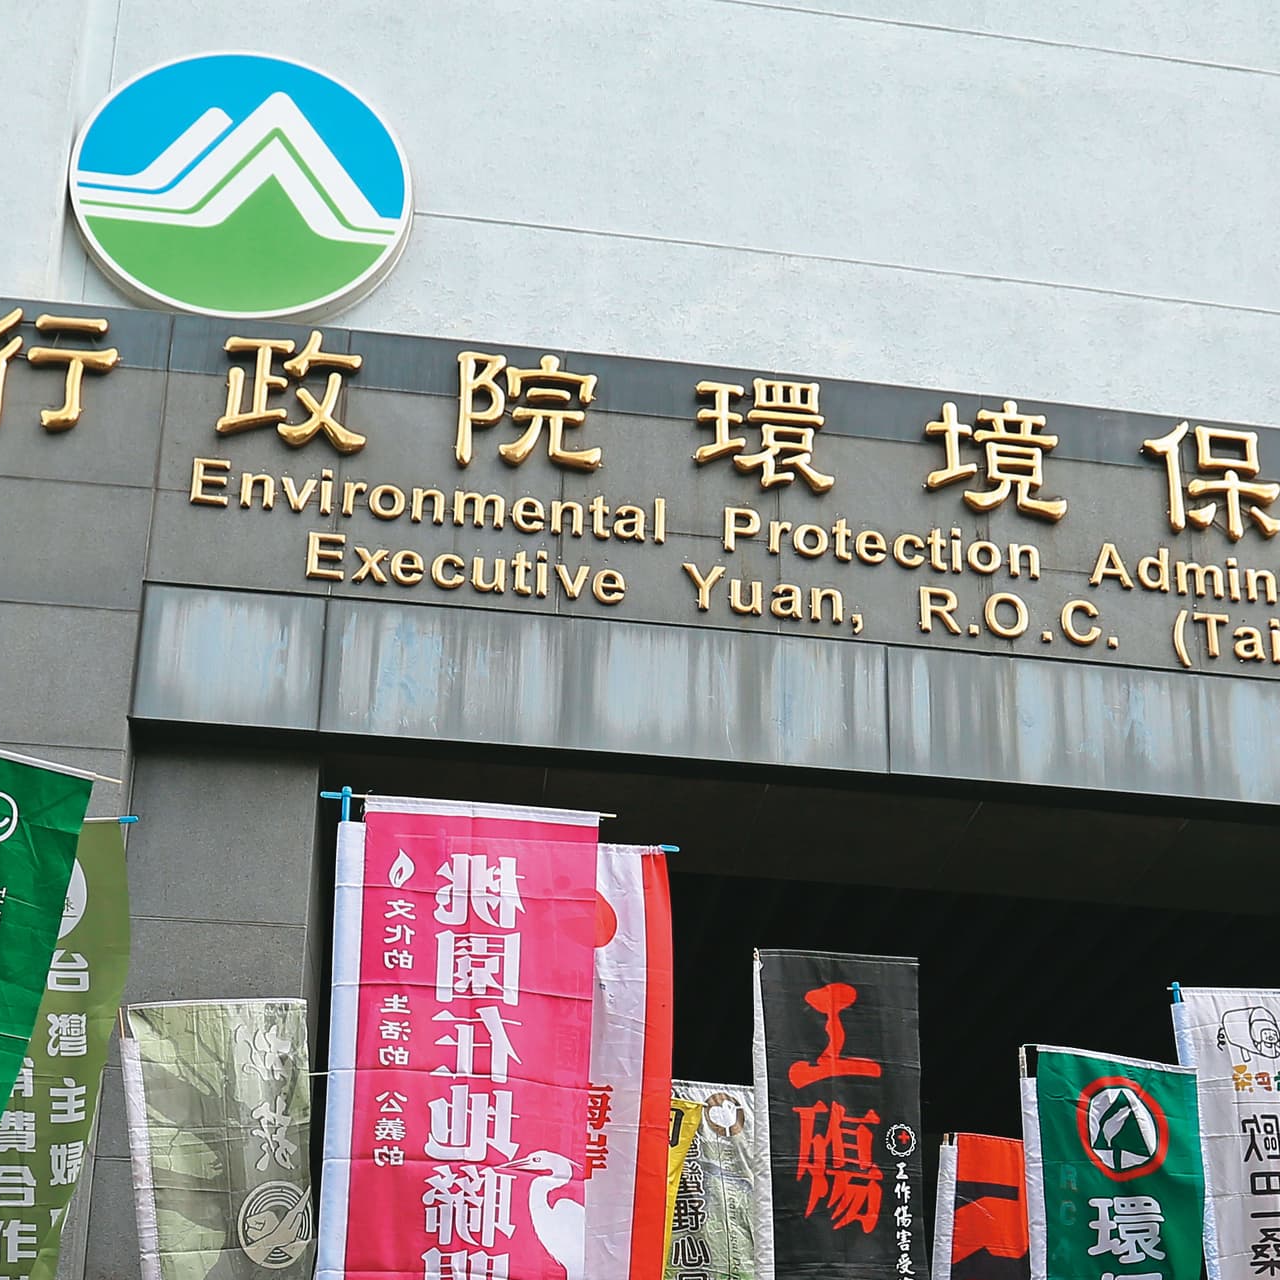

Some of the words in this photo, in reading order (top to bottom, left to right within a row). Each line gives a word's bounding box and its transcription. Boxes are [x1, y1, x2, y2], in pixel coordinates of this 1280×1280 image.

[190, 456, 666, 546] Environmental
[723, 506, 1041, 581] Protection
[305, 530, 626, 604] Executive
[682, 560, 865, 634] Yuan,
[918, 586, 1121, 650] R.O.C.
